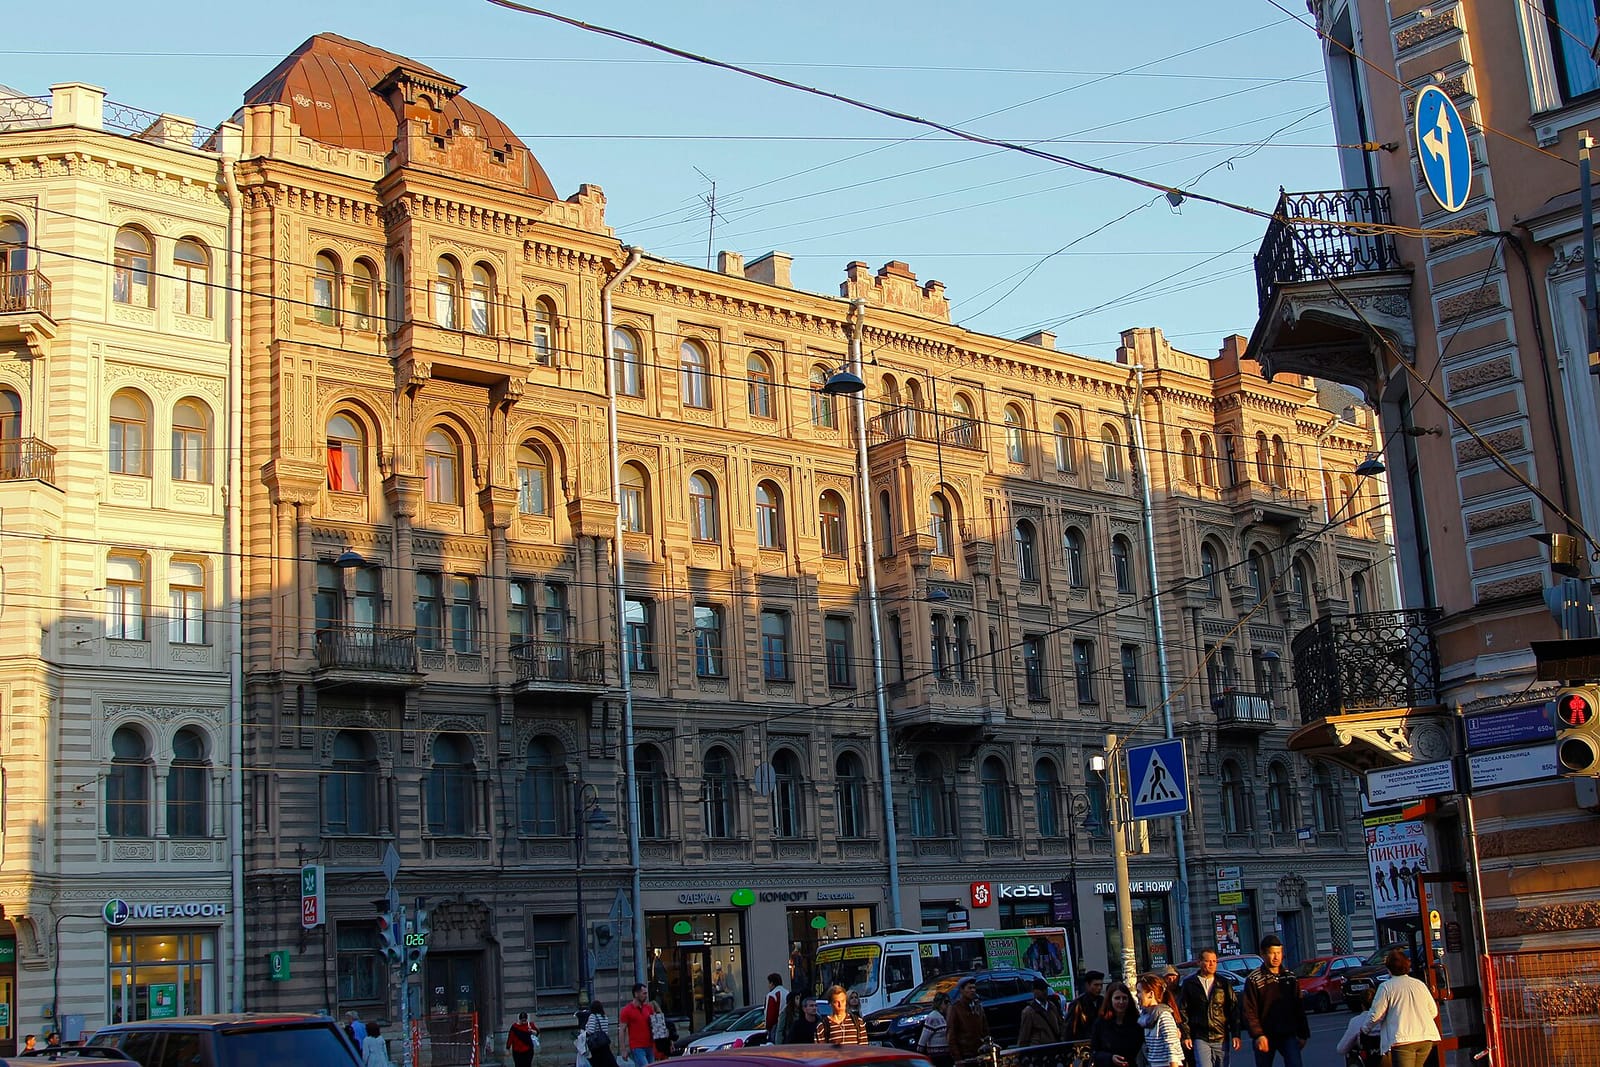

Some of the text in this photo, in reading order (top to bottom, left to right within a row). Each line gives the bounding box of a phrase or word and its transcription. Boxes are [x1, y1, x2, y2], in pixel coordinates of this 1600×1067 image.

[1381, 763, 1449, 780] ГЕНЕРАЛЬНОЕ КОНСУЛЬСТВО
[1378, 830, 1385, 843] 5
[1370, 842, 1425, 863] ПИКНИК
[1096, 880, 1173, 894] ЯПОКИЕ НОЖИ
[678, 892, 721, 904] ОДЕЖДА
[759, 891, 809, 903] КОМФОРТ
[304, 899, 315, 914] 24
